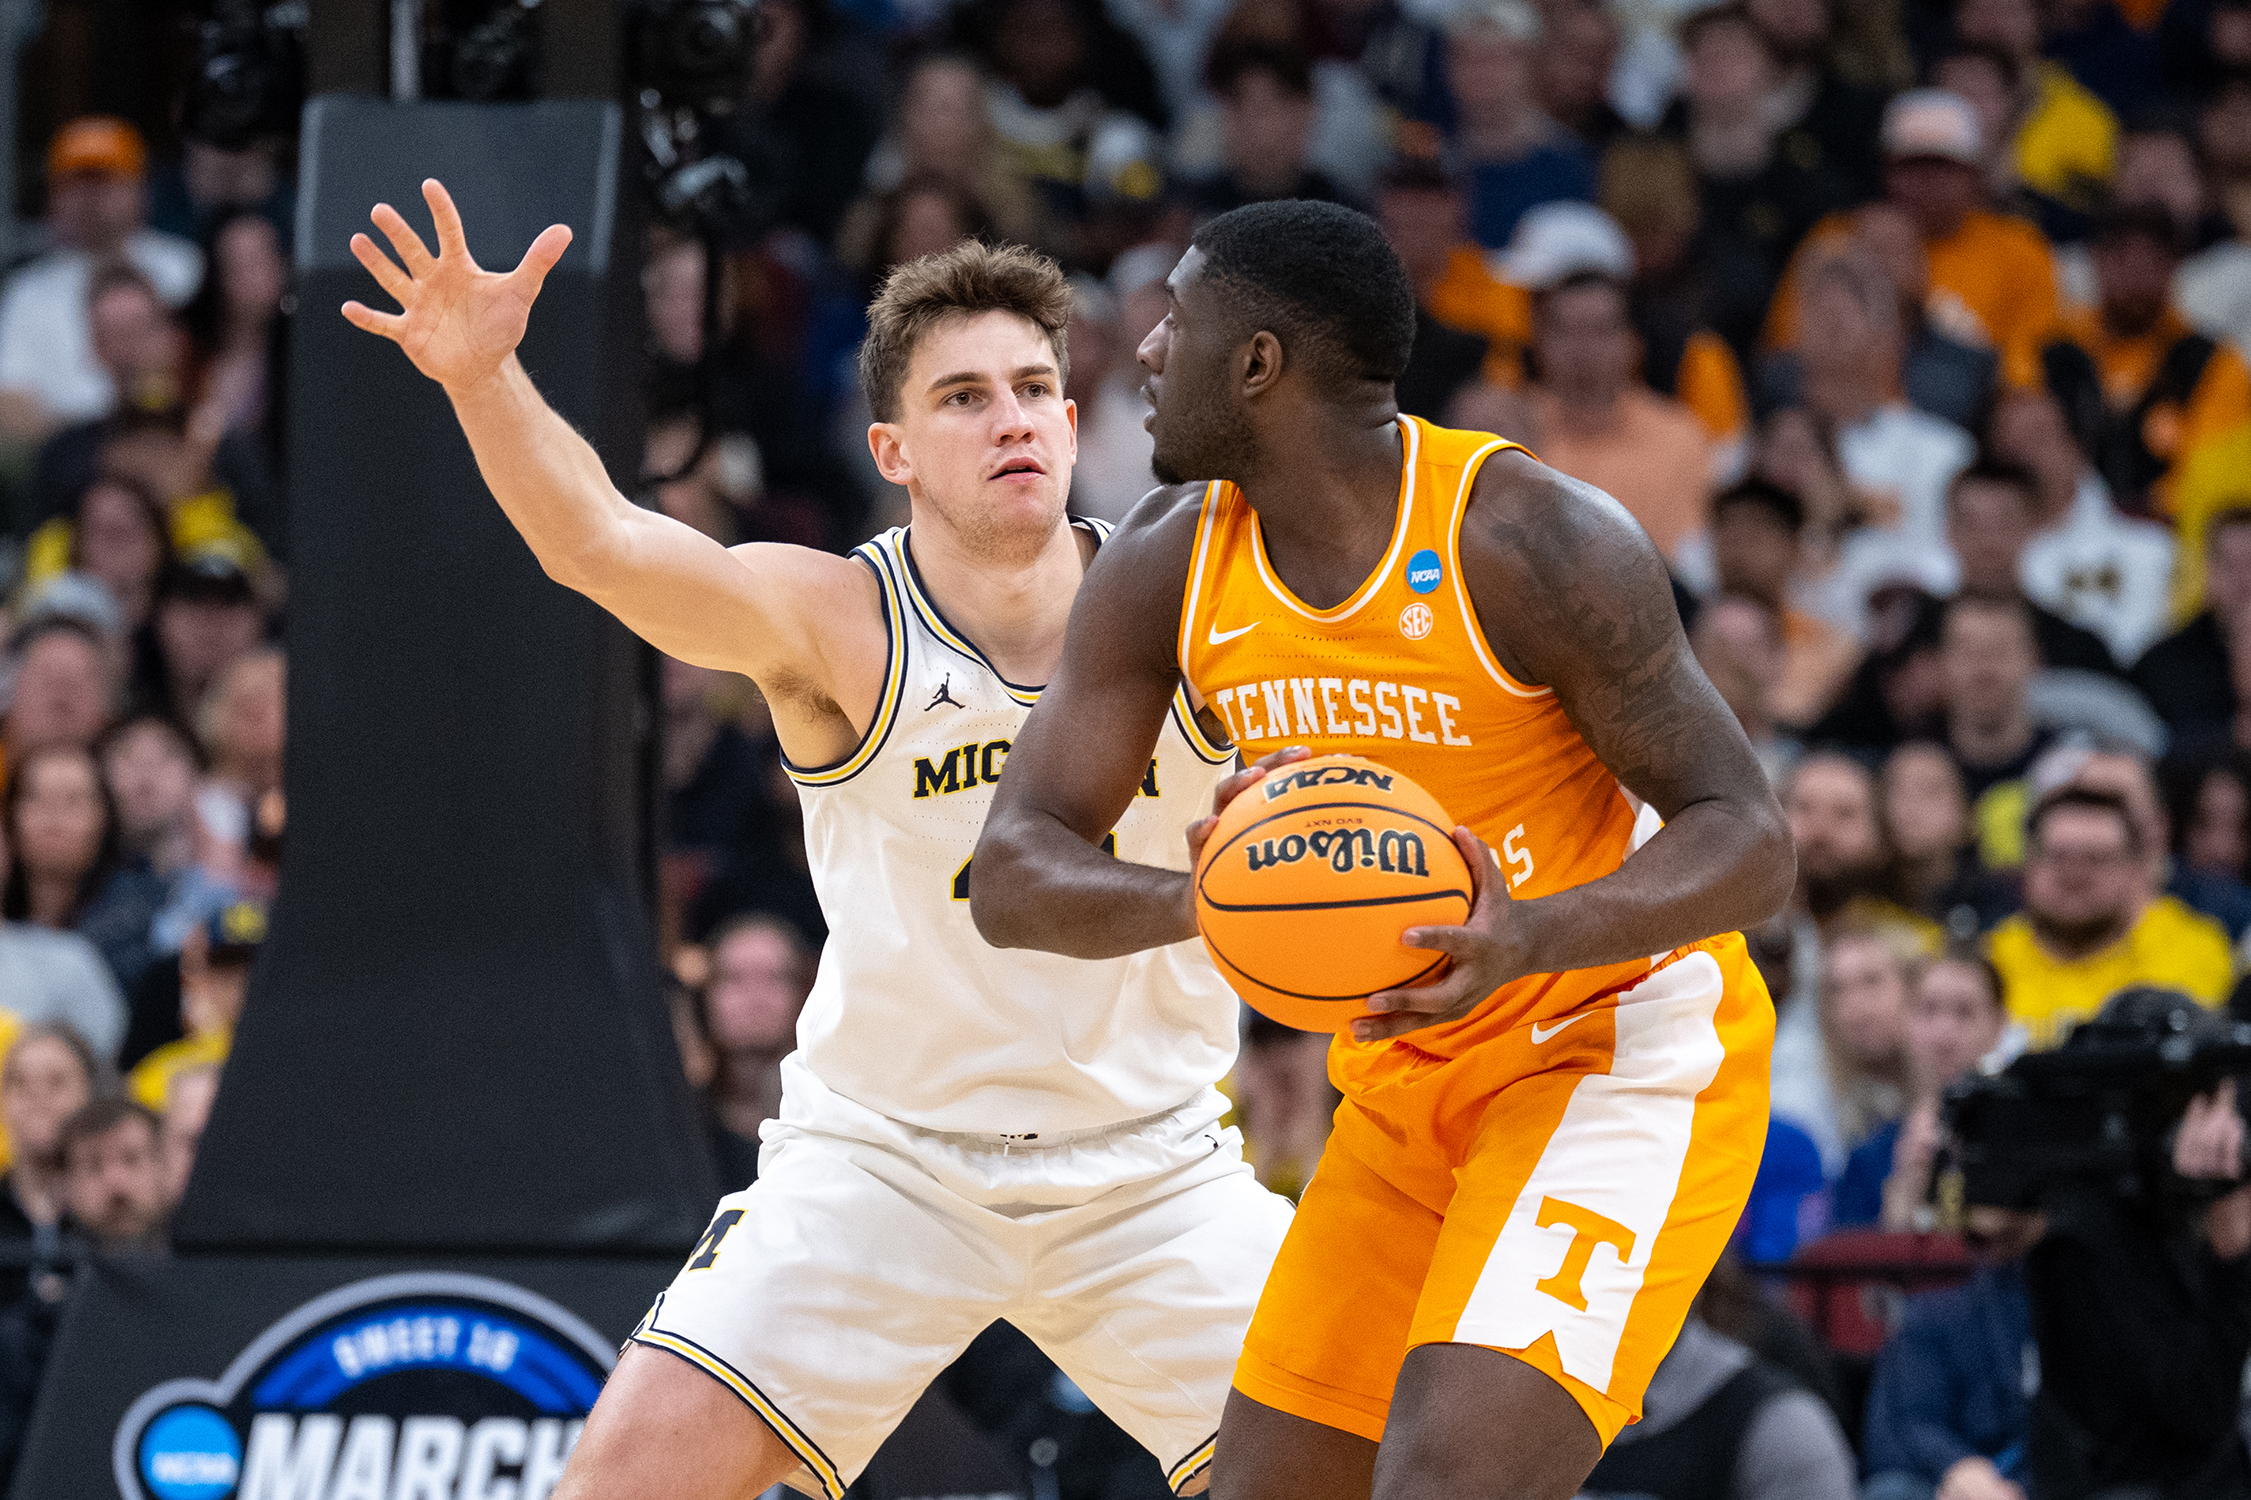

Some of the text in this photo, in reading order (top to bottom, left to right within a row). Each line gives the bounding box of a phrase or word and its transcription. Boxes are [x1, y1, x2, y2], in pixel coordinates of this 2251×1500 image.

[1411, 568, 1440, 584] NCAA
[1402, 606, 1430, 636] SEC
[1216, 677, 1472, 747] TENNESSEE
[1263, 766, 1394, 802] NCAA
[1305, 819, 1332, 828] NXT
[1245, 827, 1430, 878] Wilson
[1535, 1194, 1637, 1313] T
